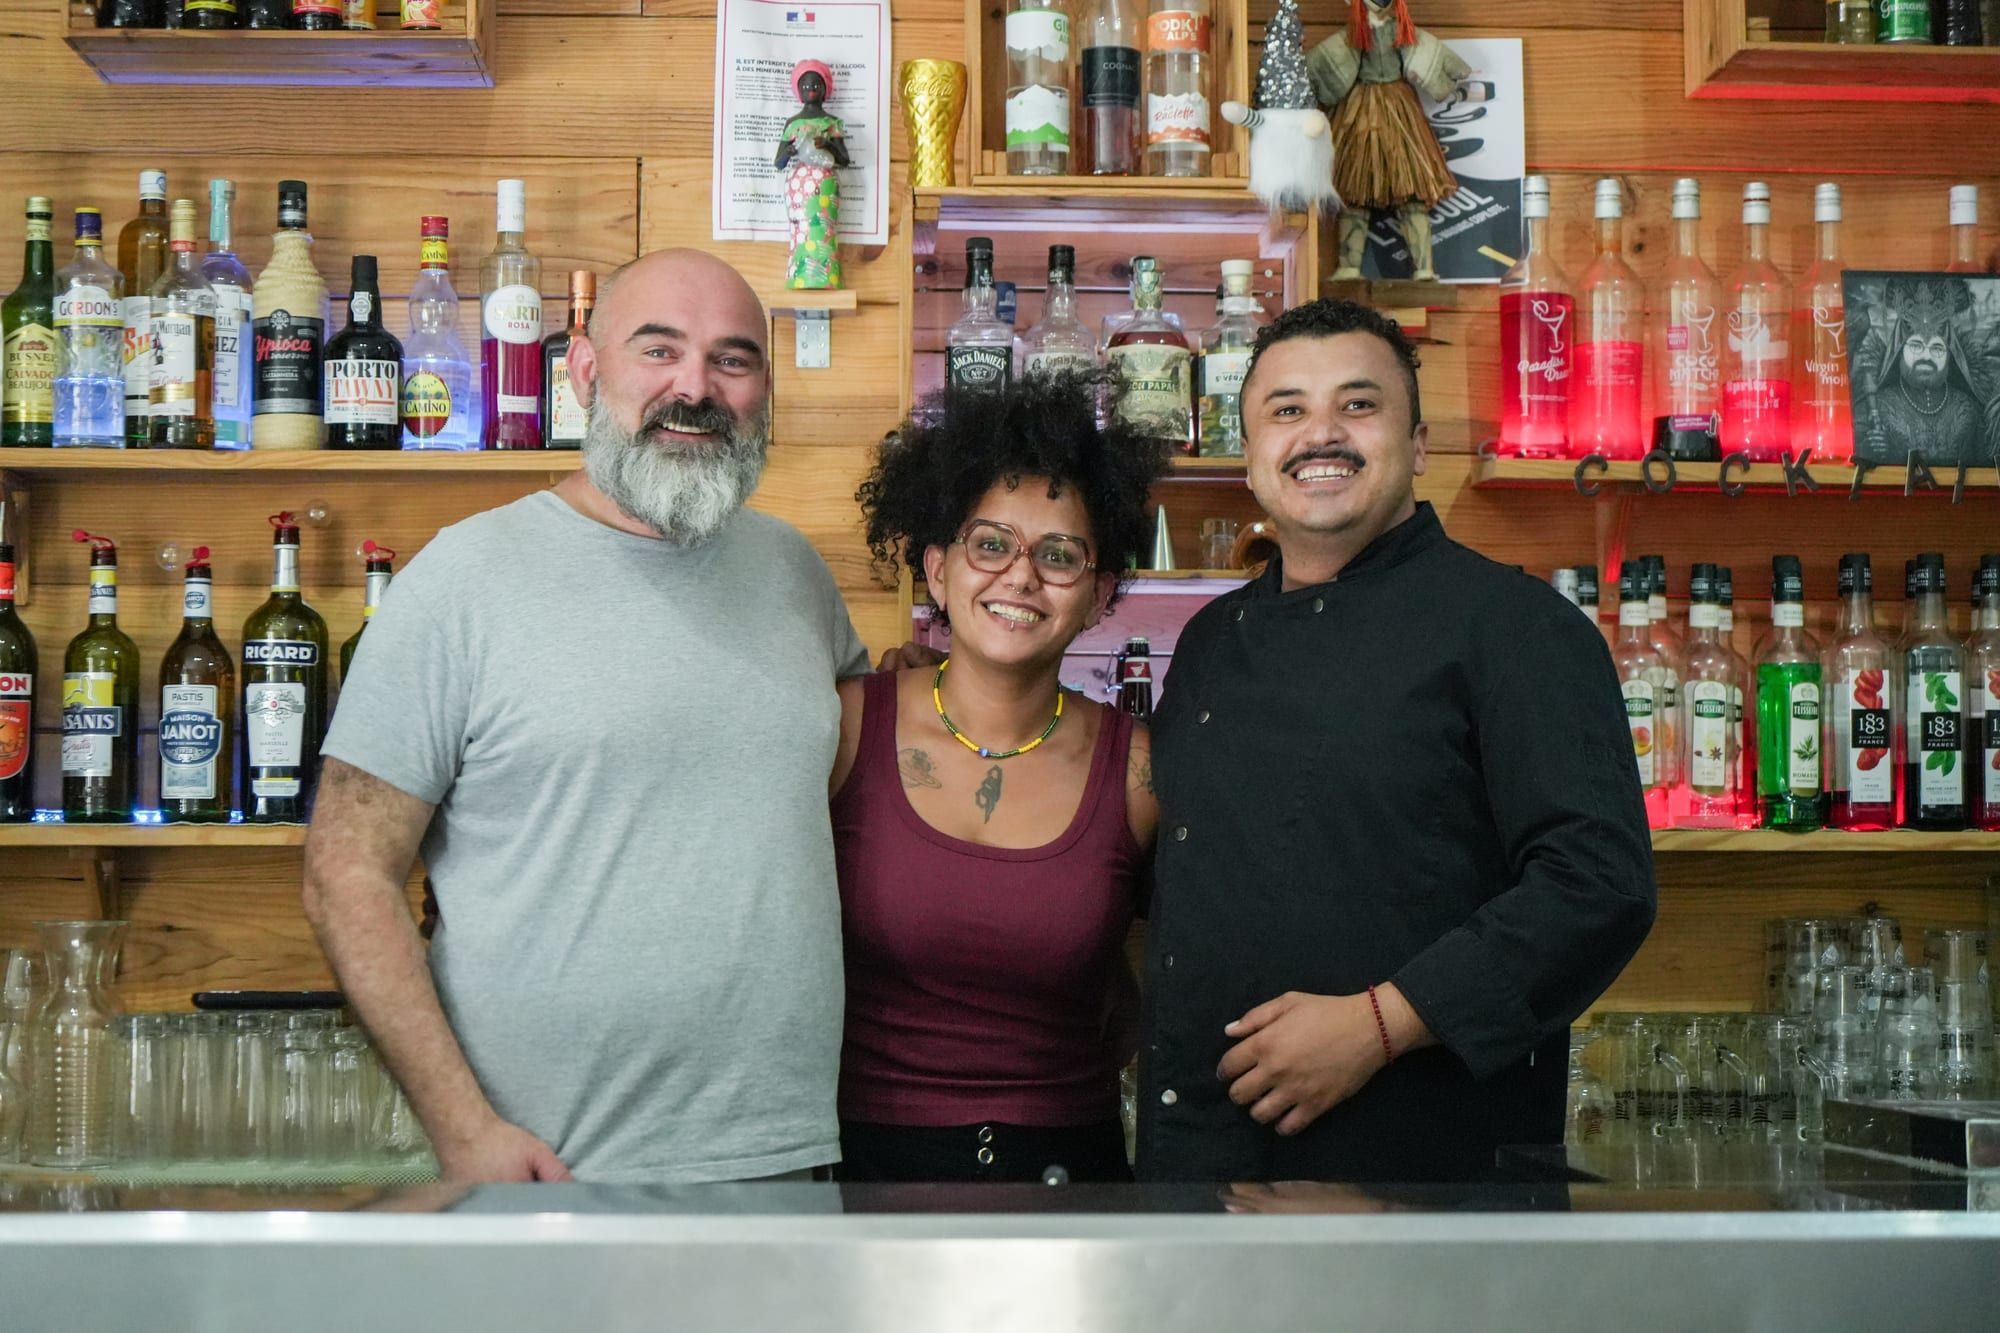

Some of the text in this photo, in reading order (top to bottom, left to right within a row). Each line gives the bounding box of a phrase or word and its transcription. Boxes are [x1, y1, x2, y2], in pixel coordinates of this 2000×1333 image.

[1053, 18, 1067, 33] GI
[1102, 61, 1137, 72] COGNAC
[494, 304, 540, 322] SARTI
[508, 321, 530, 330] ROSA
[952, 349, 1008, 370] JACK DANIEL'S
[332, 361, 396, 379] PORTO
[1805, 359, 1840, 377] Virgin
[245, 645, 312, 660] RICARD
[169, 713, 206, 723] MAISON
[161, 724, 218, 740] JANOT
